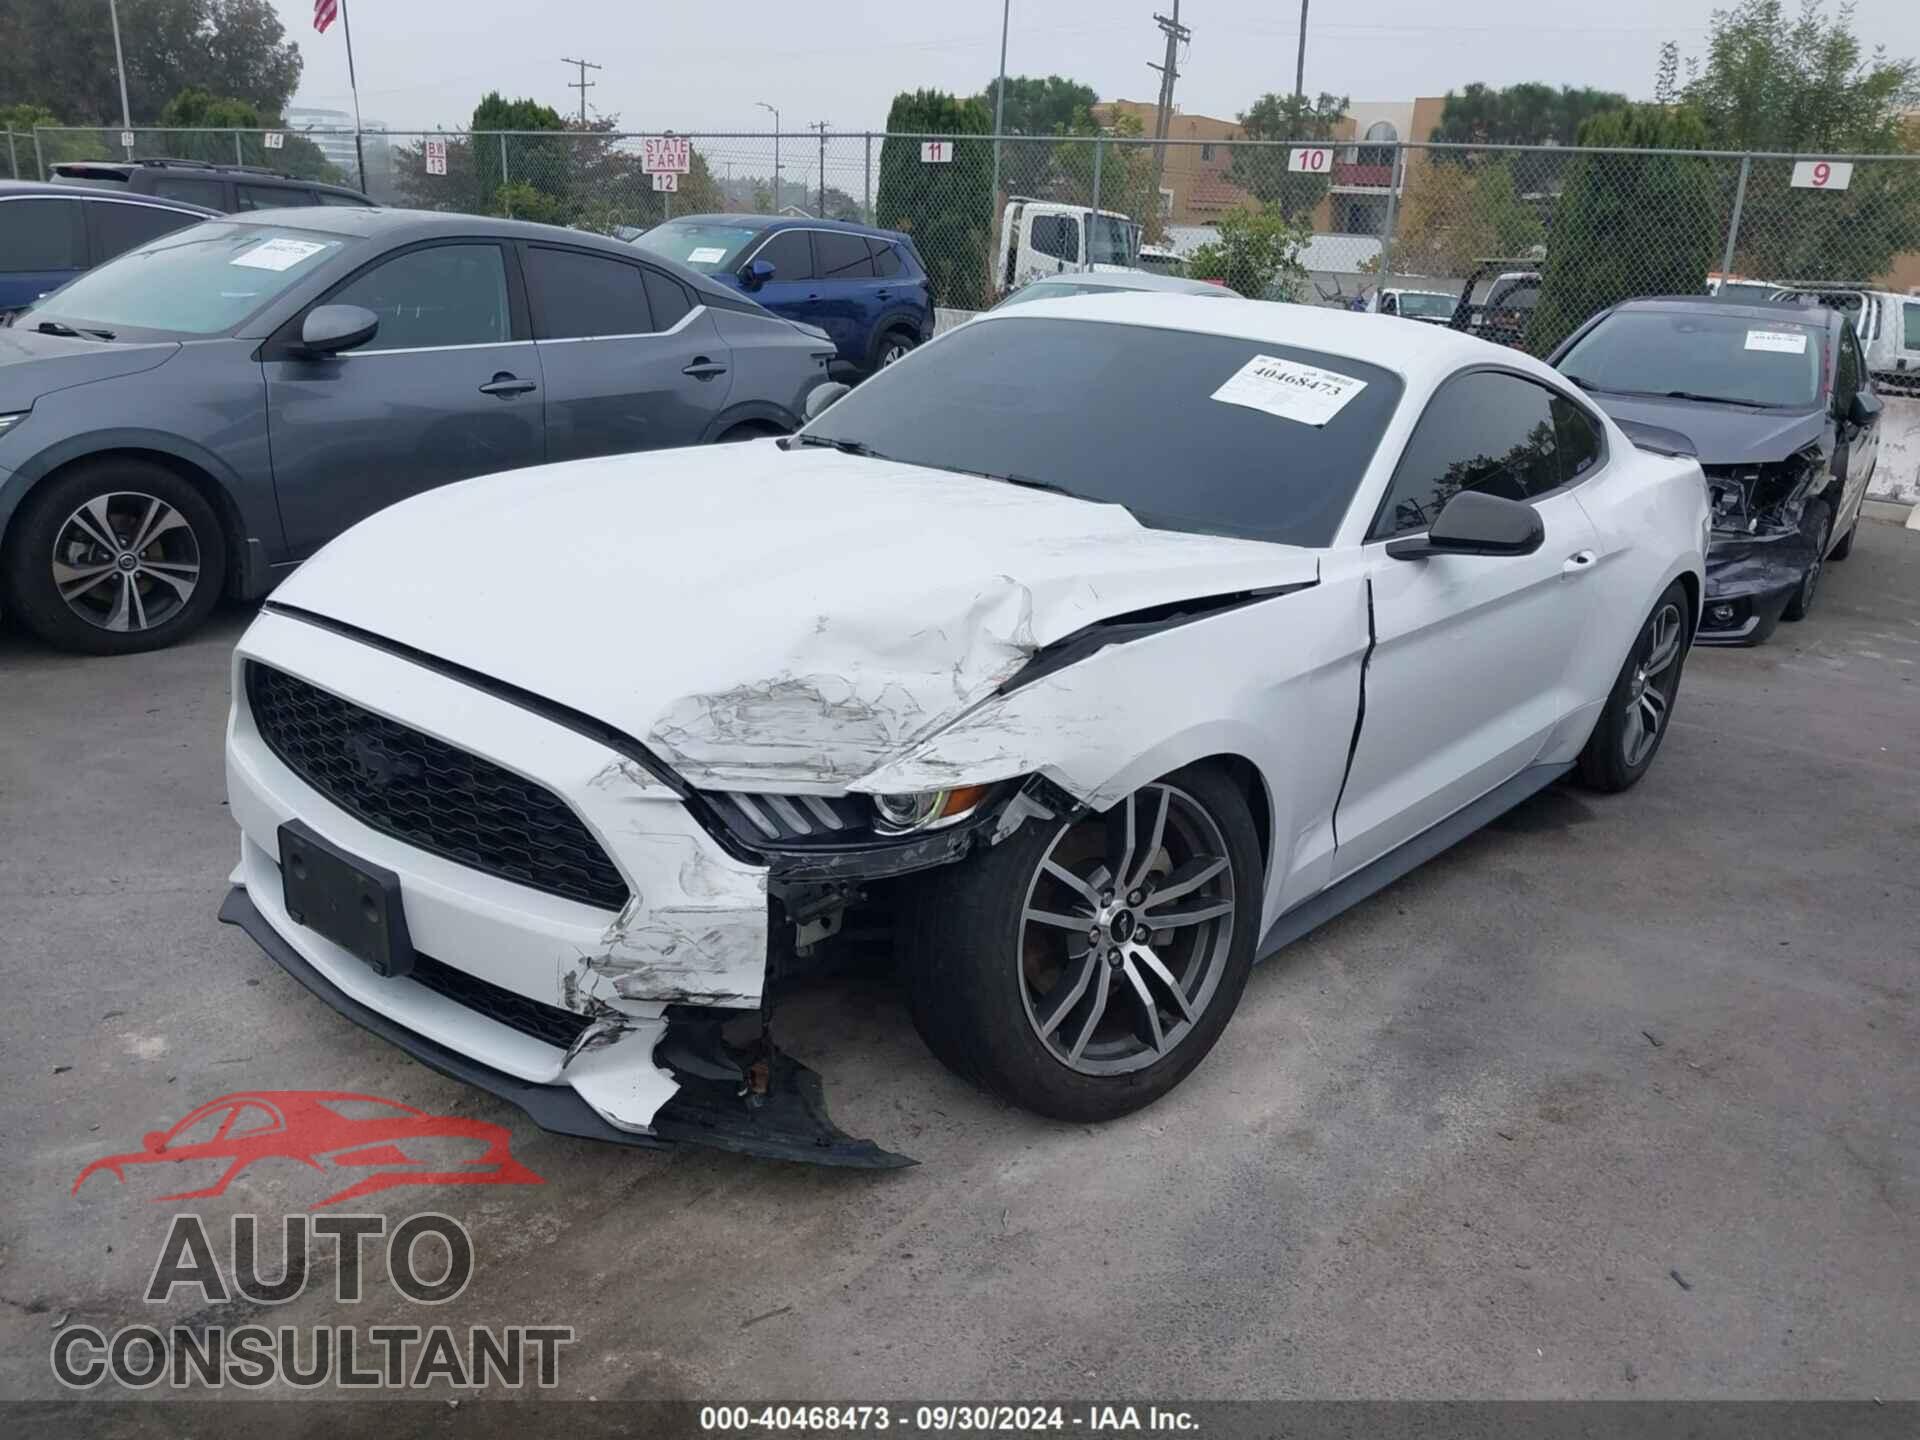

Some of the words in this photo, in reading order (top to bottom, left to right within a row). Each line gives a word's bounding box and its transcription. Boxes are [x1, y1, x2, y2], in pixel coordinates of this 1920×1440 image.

[266, 134, 281, 148] 14
[646, 139, 688, 153] STATE
[928, 144, 941, 160] 11
[1299, 150, 1324, 170] 10
[431, 159, 444, 173] 13
[647, 154, 687, 168] FARM
[657, 174, 673, 190] 12
[1812, 163, 1831, 186] 9
[1253, 366, 1342, 397] 40468473
